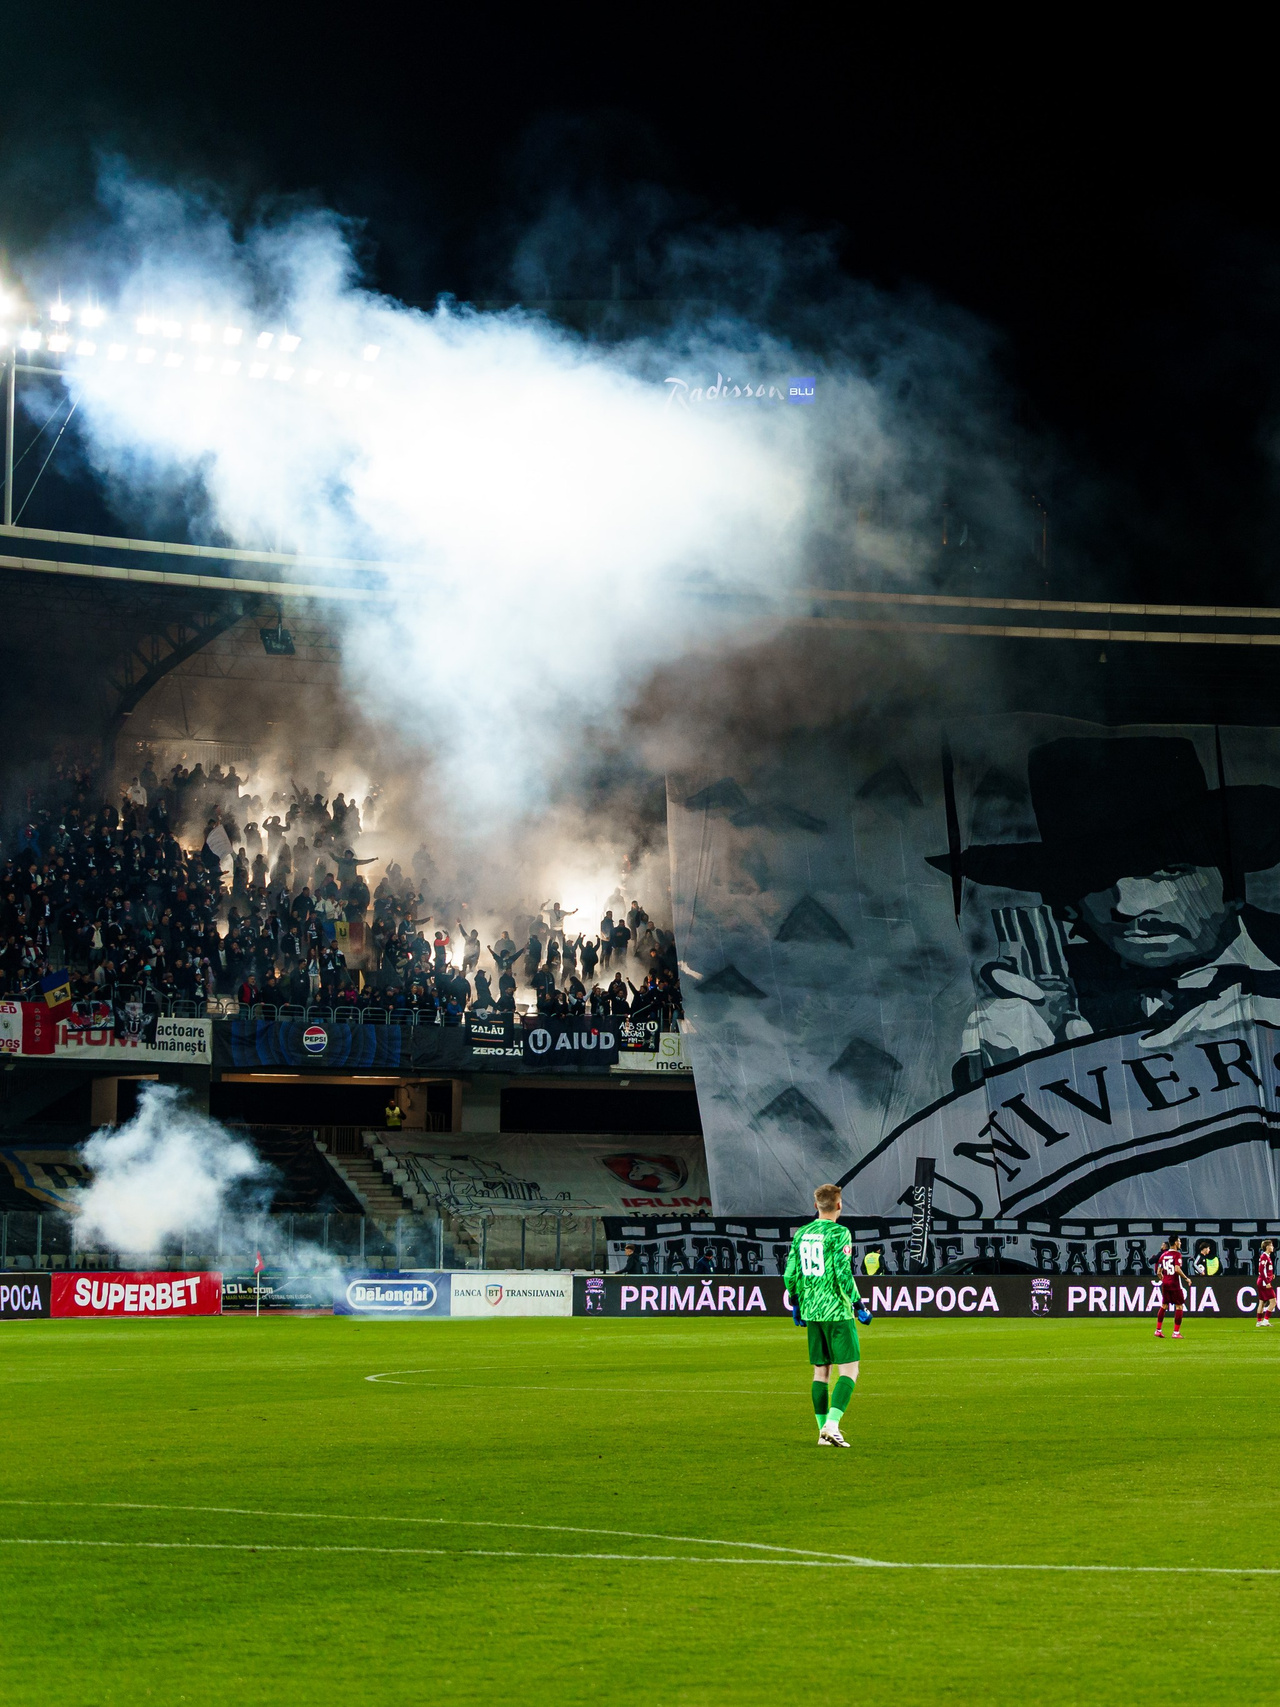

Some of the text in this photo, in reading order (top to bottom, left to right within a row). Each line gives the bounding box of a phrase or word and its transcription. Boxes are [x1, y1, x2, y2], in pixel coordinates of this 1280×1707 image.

[664, 372, 814, 413] Radisson BLU
[554, 1032, 615, 1050] AIUD
[472, 1047, 504, 1056] ZERO
[622, 1196, 712, 1208] IRUM
[800, 1241, 825, 1277] 89
[1162, 1258, 1175, 1276] 45
[74, 1277, 201, 1312] SUPERBET
[454, 1289, 565, 1298] BANCA BT TRANSILVANIA
[620, 1280, 767, 1311] PRIMĂRIA
